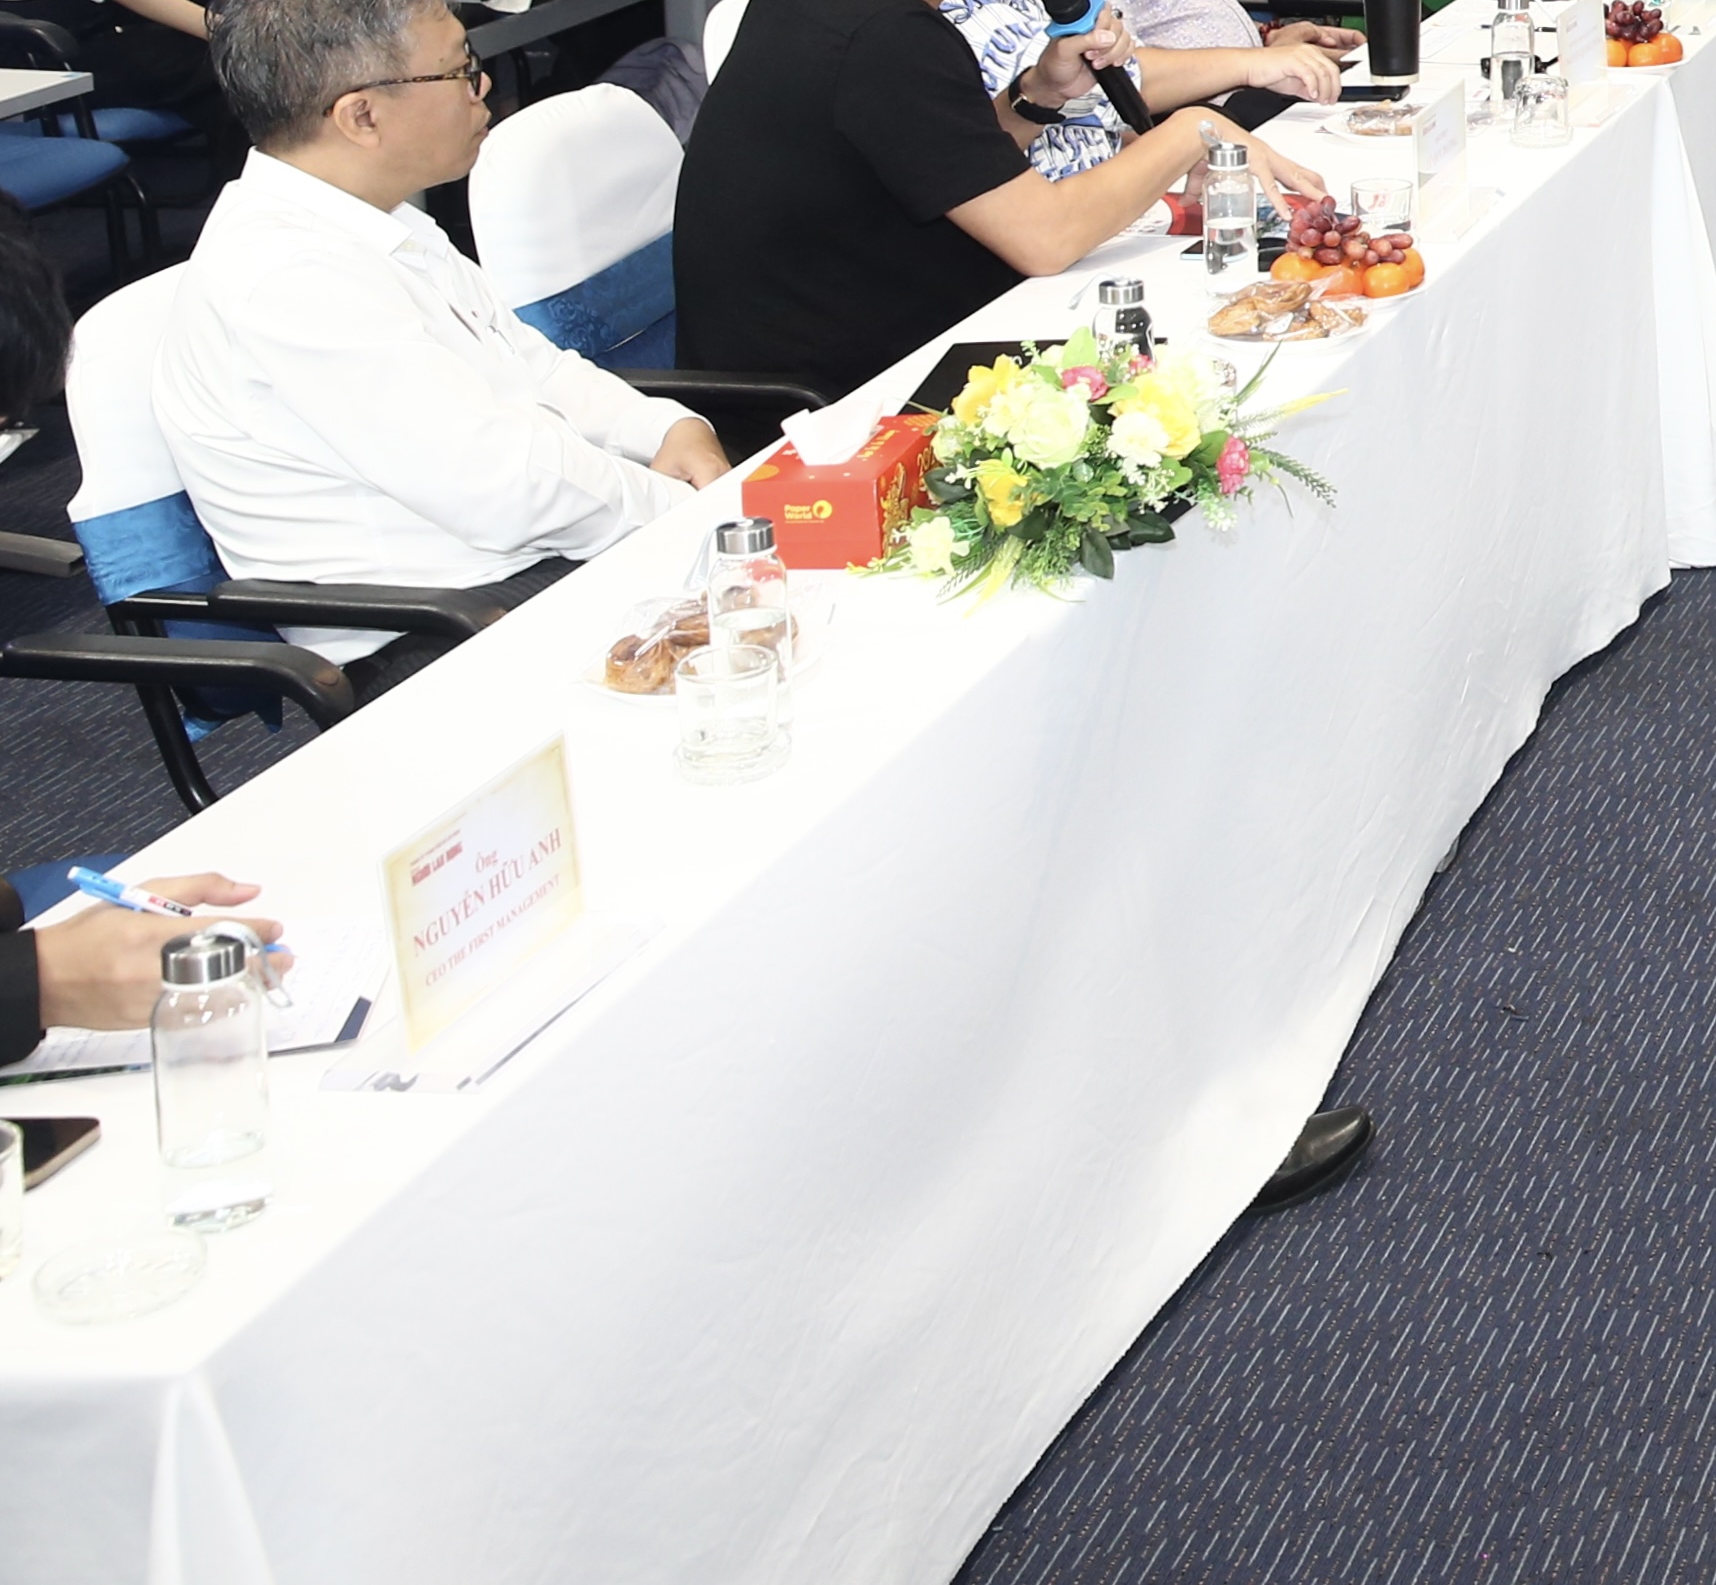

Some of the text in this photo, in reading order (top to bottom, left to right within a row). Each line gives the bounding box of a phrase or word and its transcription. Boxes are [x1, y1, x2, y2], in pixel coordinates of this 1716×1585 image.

[475, 849, 499, 874] Ông
[528, 827, 562, 871] ANH
[425, 873, 561, 987] CEO THE FIRST MANAGEMENT
